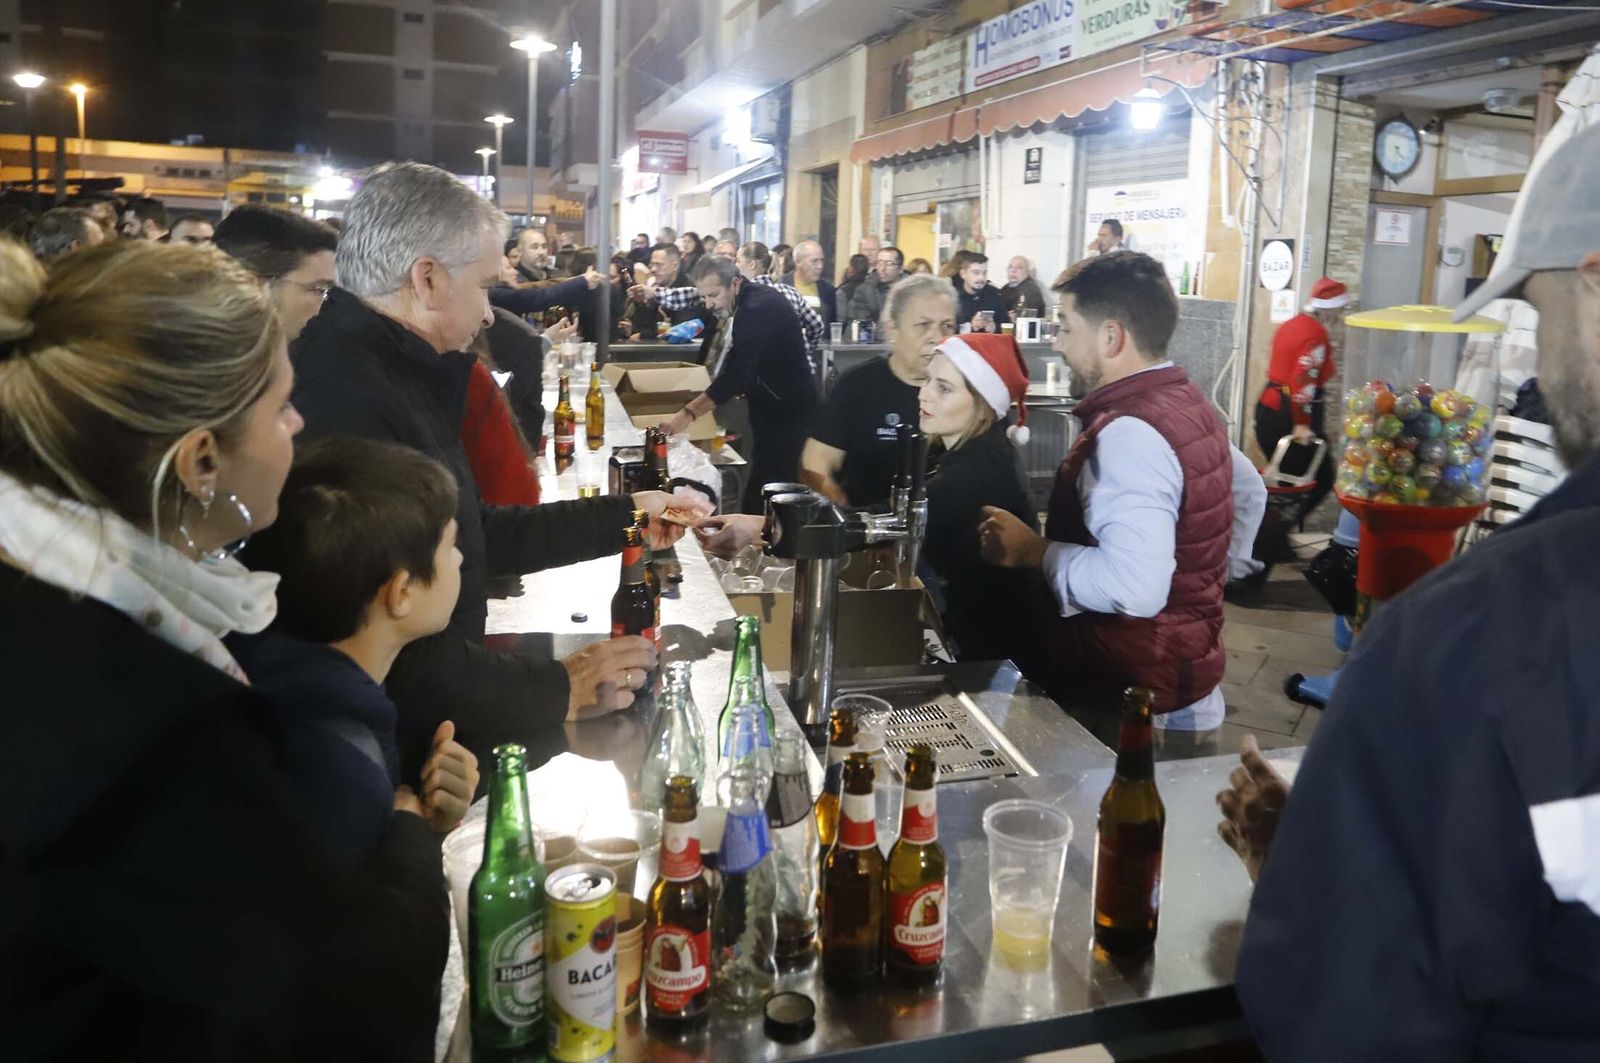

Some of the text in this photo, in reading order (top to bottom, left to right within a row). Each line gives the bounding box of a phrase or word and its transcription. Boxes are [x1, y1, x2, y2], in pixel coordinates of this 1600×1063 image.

[1081, 0, 1151, 35] VERDURAS
[974, 0, 1074, 67] HOMOBONUS
[1124, 210, 1135, 221] DE
[1262, 260, 1289, 272] BAZAR
